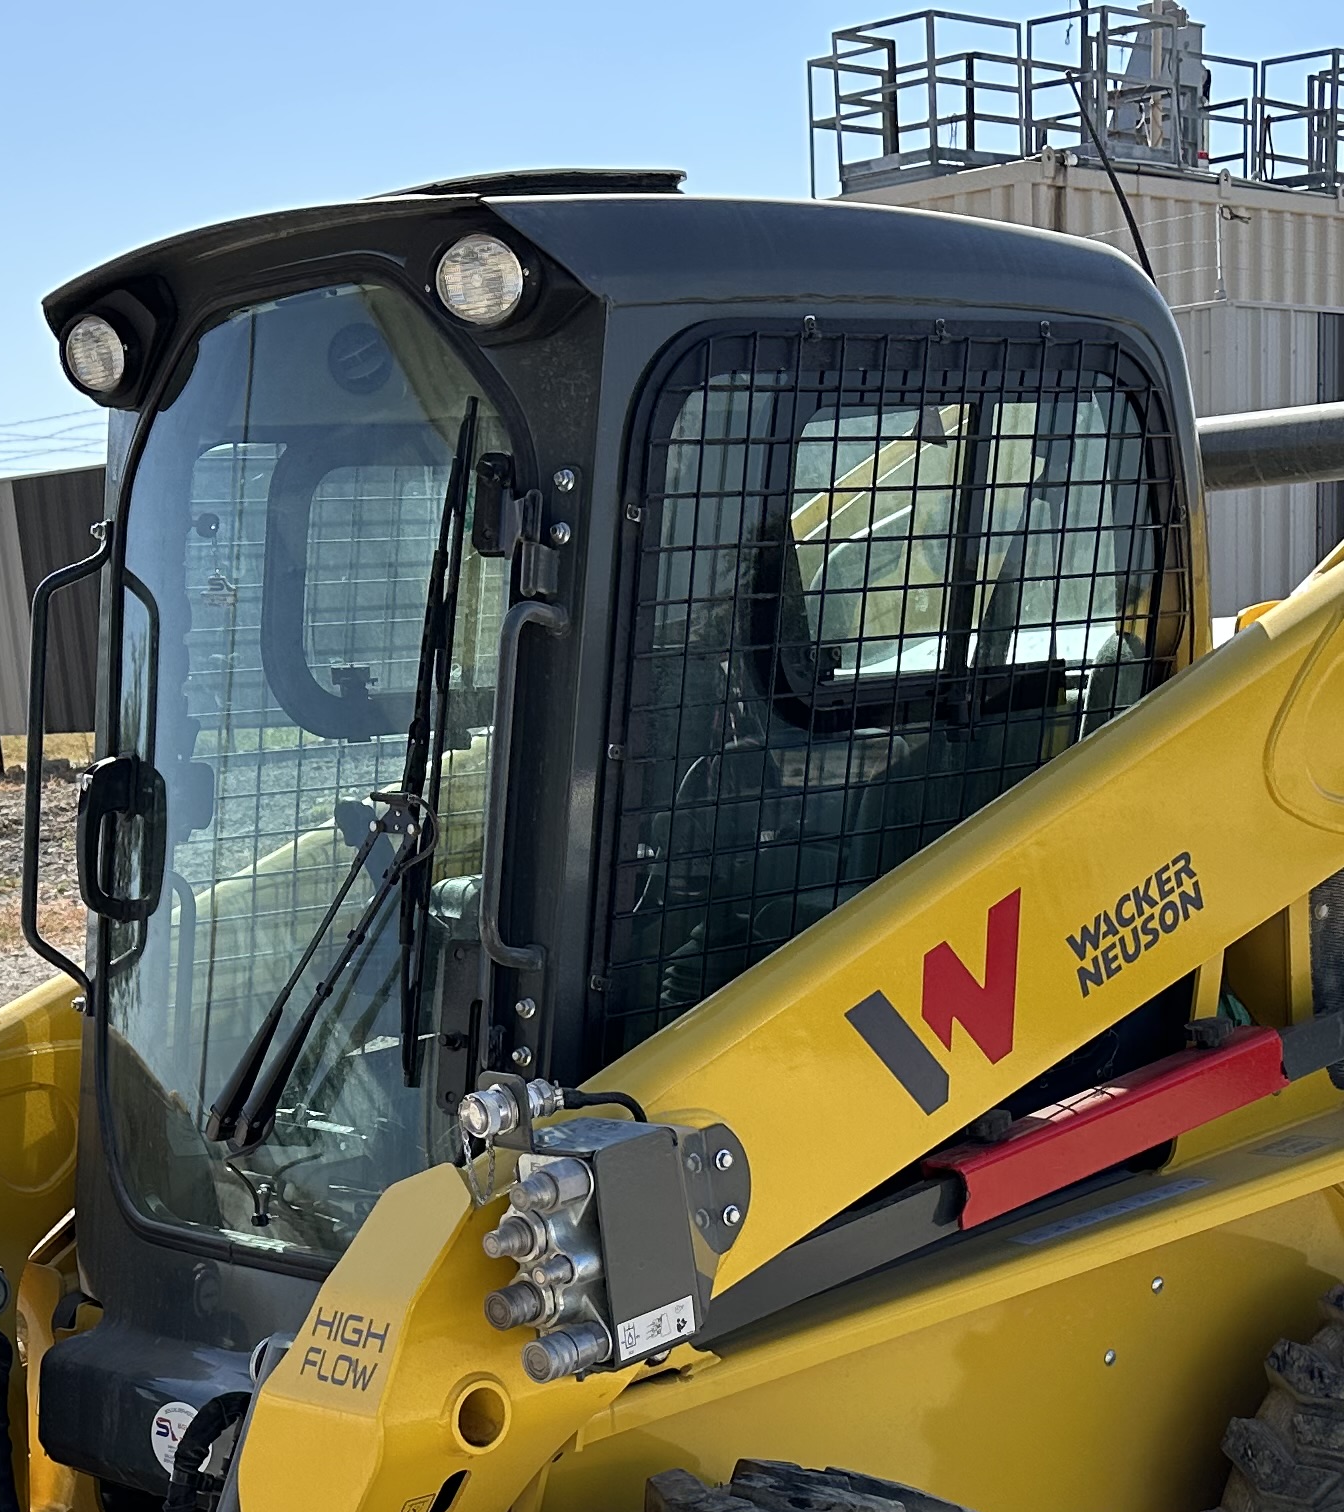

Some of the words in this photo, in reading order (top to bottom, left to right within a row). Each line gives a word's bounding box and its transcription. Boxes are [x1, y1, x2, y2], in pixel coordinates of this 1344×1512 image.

[1065, 851, 1197, 962] WACKER
[1076, 879, 1204, 999] NEUSON
[300, 1346, 379, 1392] FLOW
[312, 1306, 391, 1353] HIGH
